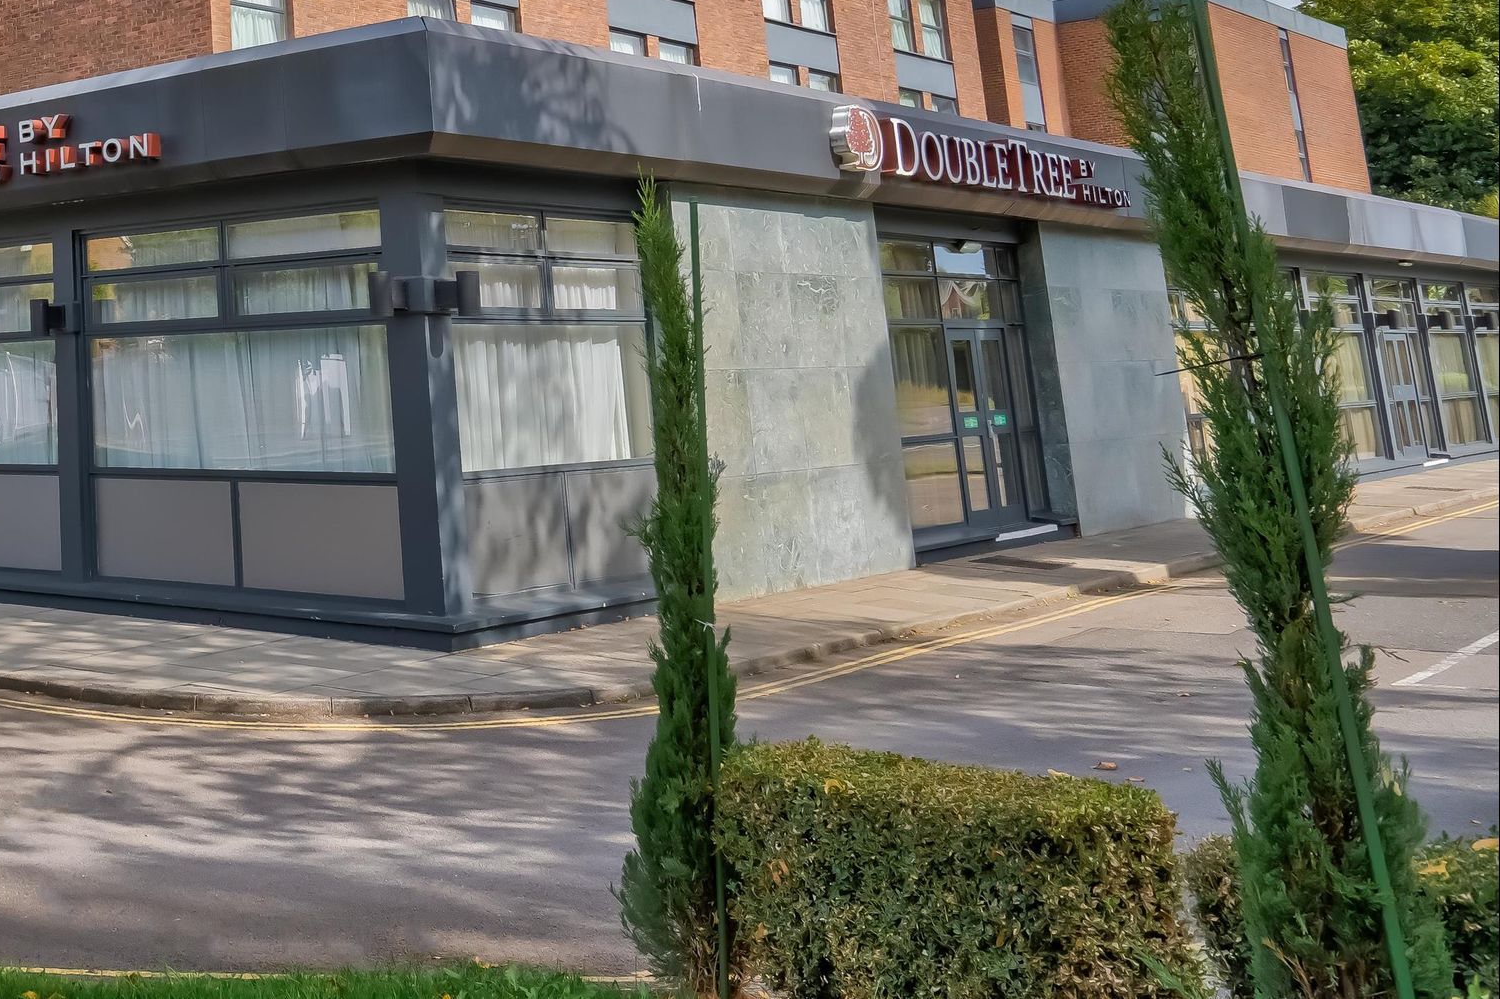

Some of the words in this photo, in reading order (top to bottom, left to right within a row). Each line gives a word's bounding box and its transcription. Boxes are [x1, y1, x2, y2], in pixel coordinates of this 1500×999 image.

[18, 114, 64, 143] BY
[20, 133, 151, 175] HILTON
[890, 117, 1077, 200] DOUBLETREE
[1079, 159, 1096, 178] BY
[1082, 183, 1132, 207] HILTON
